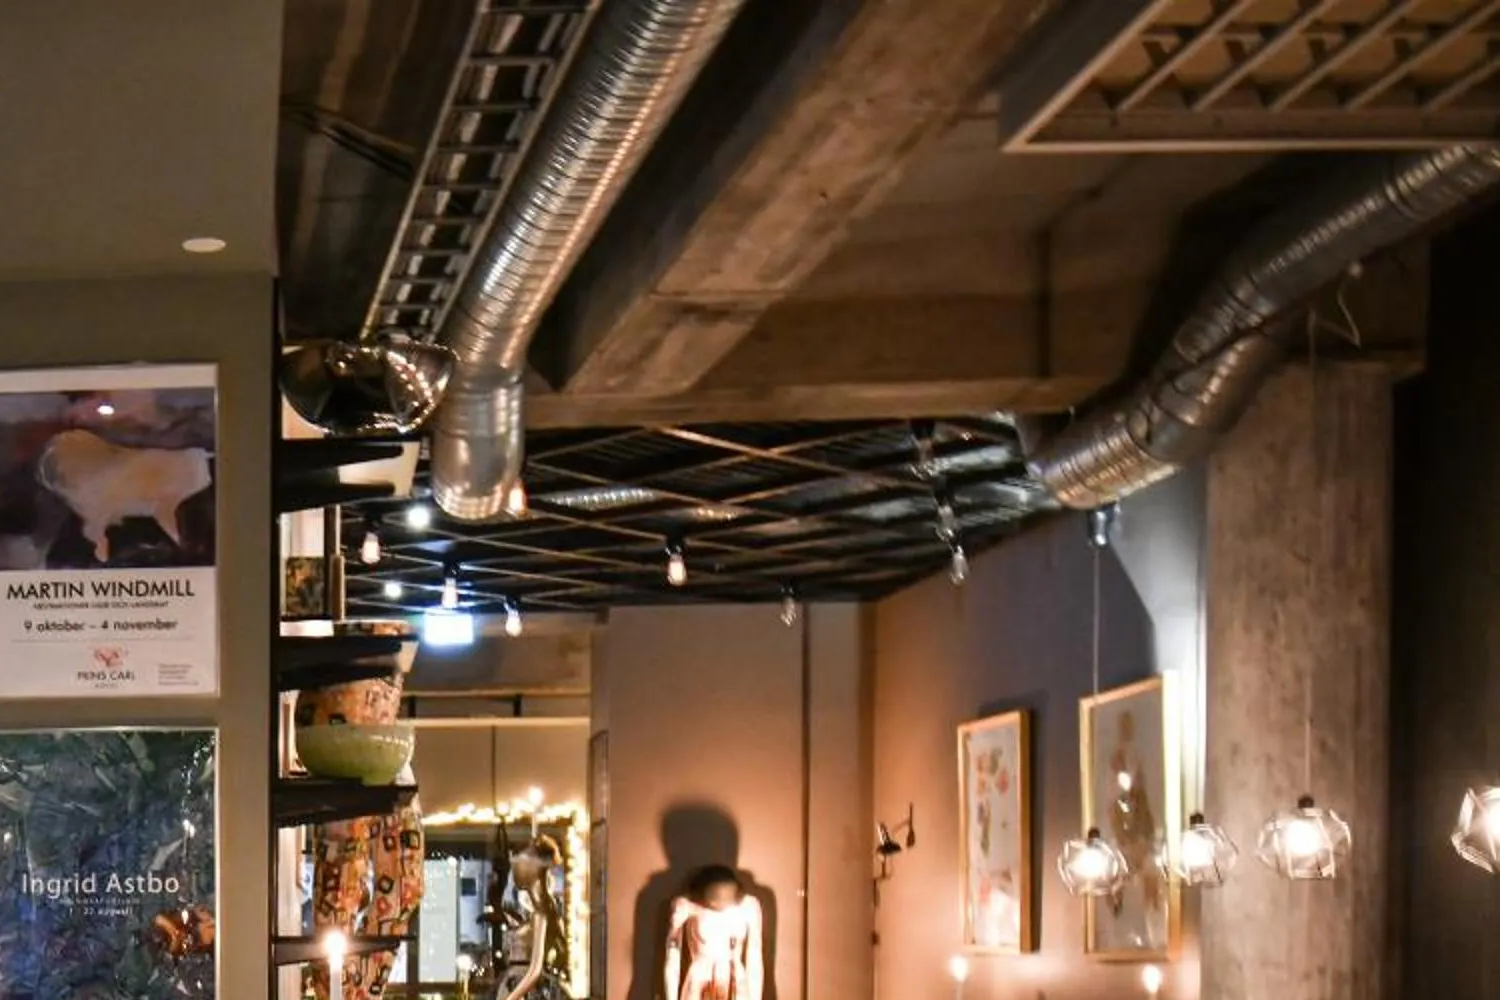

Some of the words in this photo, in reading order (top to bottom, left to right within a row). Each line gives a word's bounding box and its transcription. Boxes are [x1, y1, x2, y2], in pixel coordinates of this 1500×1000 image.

[6, 580, 85, 600] MARTIN
[91, 578, 196, 598] WINDMILL
[23, 620, 33, 631] 9
[35, 618, 85, 632] oktober
[99, 619, 109, 630] 4
[113, 617, 179, 631] november
[22, 871, 97, 900] Ingrid
[105, 870, 180, 894] Astbo
